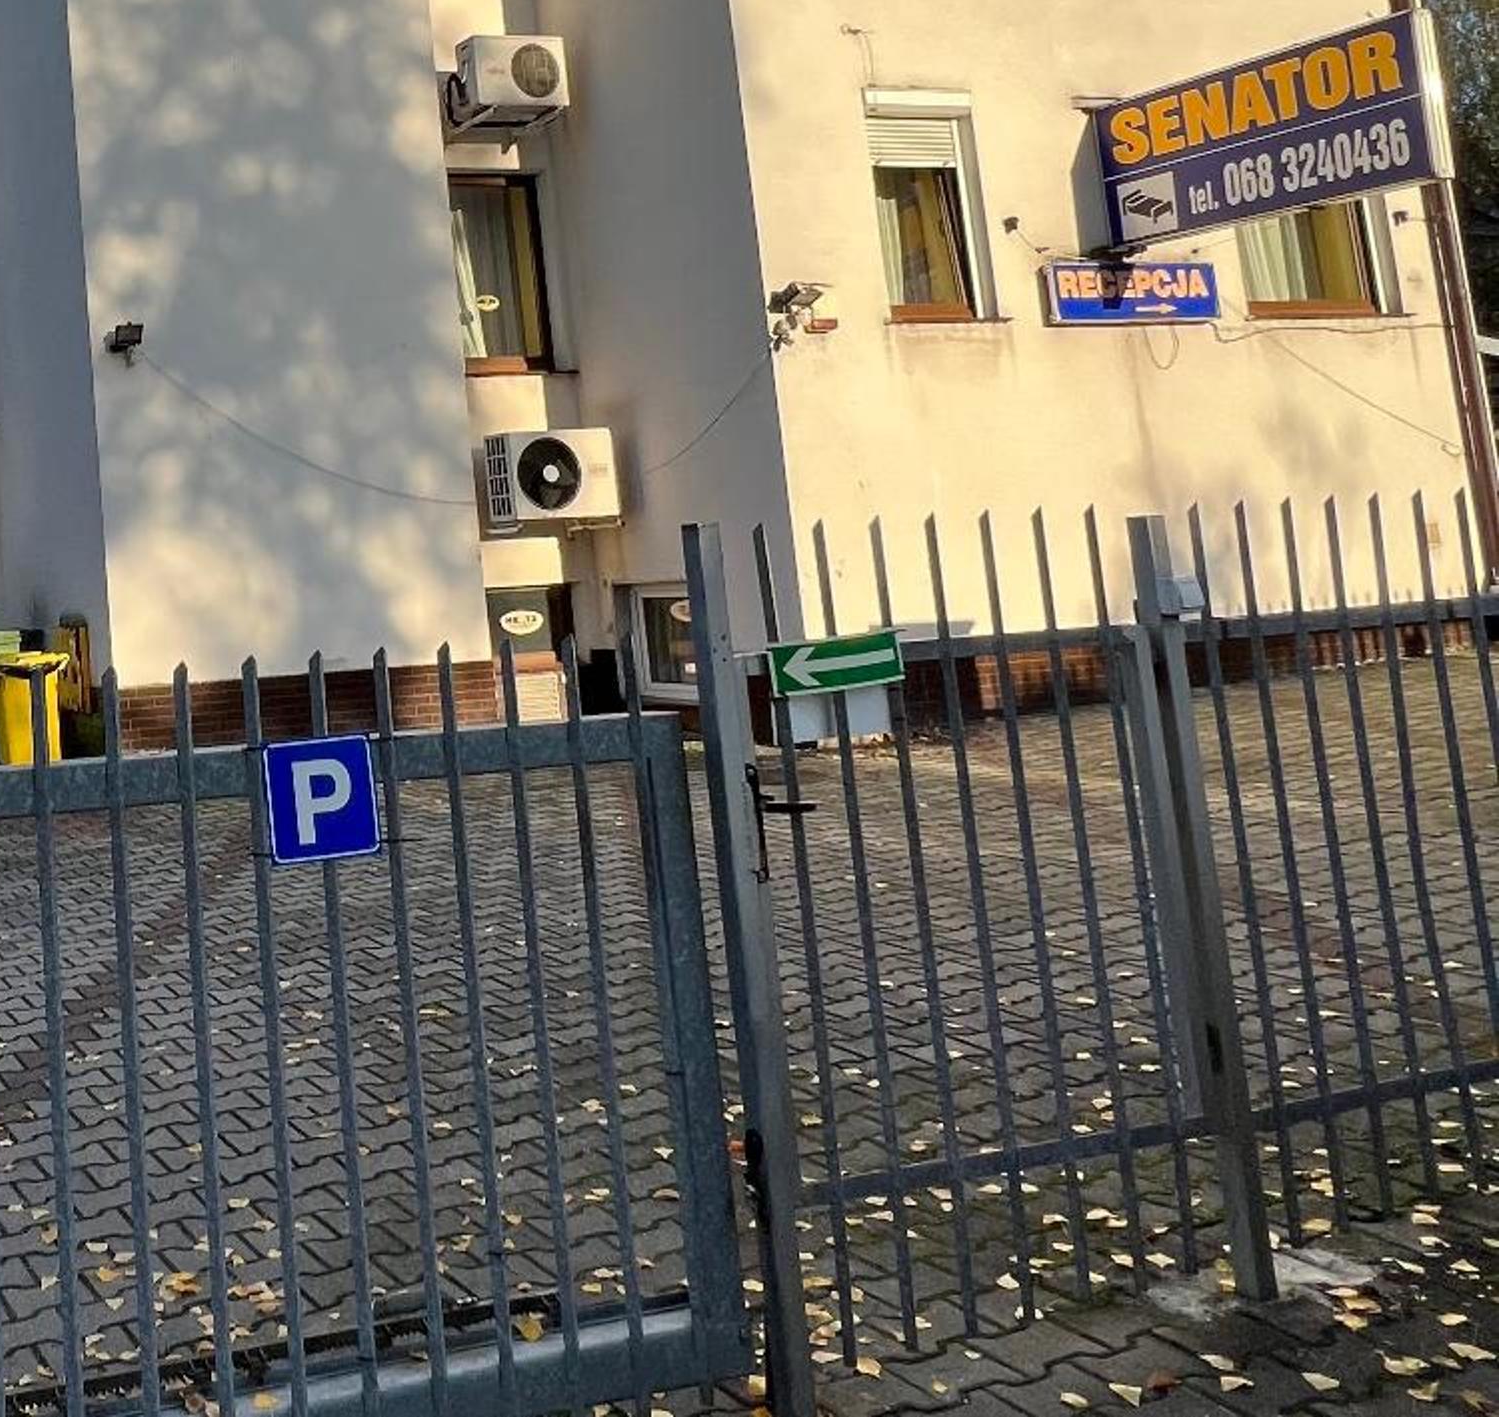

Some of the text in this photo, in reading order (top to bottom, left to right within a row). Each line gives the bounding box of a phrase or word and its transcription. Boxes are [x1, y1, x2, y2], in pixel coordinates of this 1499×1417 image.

[1109, 31, 1403, 166] SENATOR
[1188, 119, 1411, 215] tel. 068 3240436
[1056, 269, 1210, 299] RECEPCJA
[291, 758, 351, 846] P
